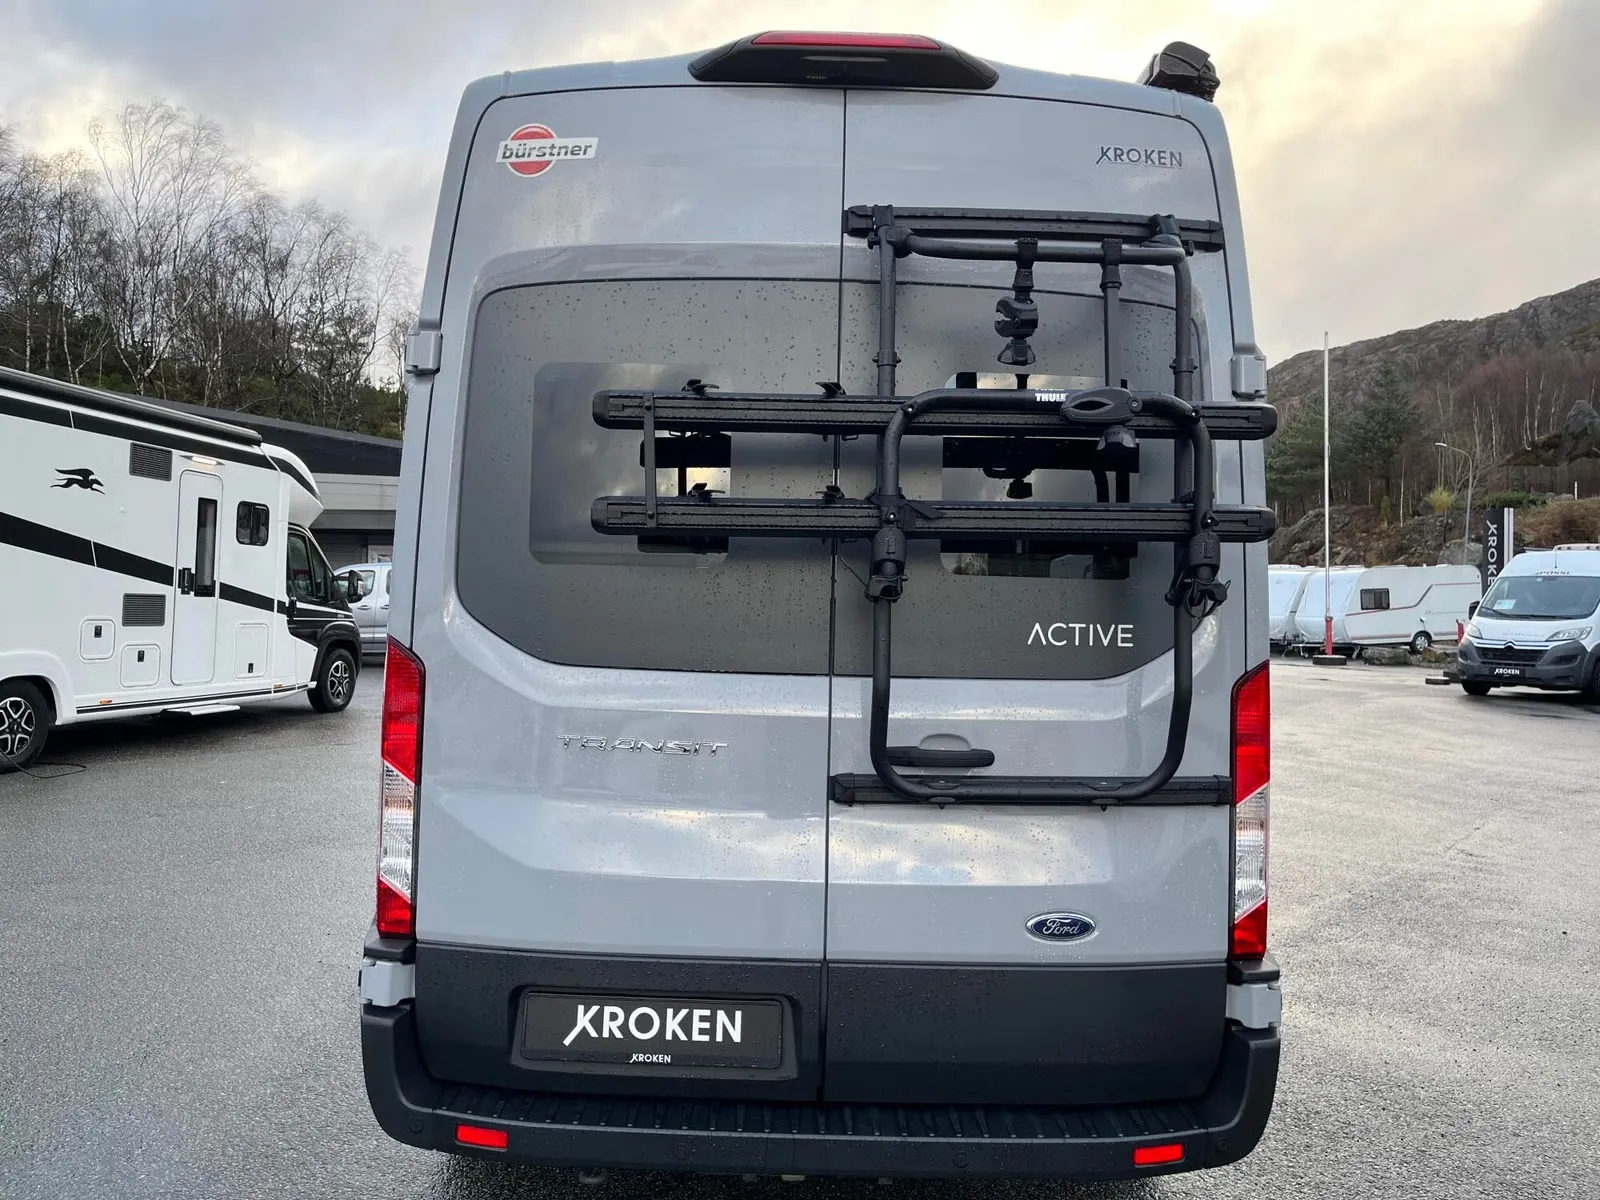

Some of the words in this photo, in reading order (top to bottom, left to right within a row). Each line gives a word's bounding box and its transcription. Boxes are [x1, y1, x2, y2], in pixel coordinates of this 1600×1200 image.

[501, 143, 593, 160] bürstner
[1095, 146, 1183, 168] KROKEN
[1035, 392, 1067, 402] THULE
[1486, 519, 1498, 586] KROKE
[1027, 622, 1134, 647] ACTIVE
[555, 734, 728, 756] TRANSIT
[1042, 918, 1081, 935] Ford
[562, 1004, 742, 1047] KROKEN
[629, 1053, 672, 1064] KROKEN
